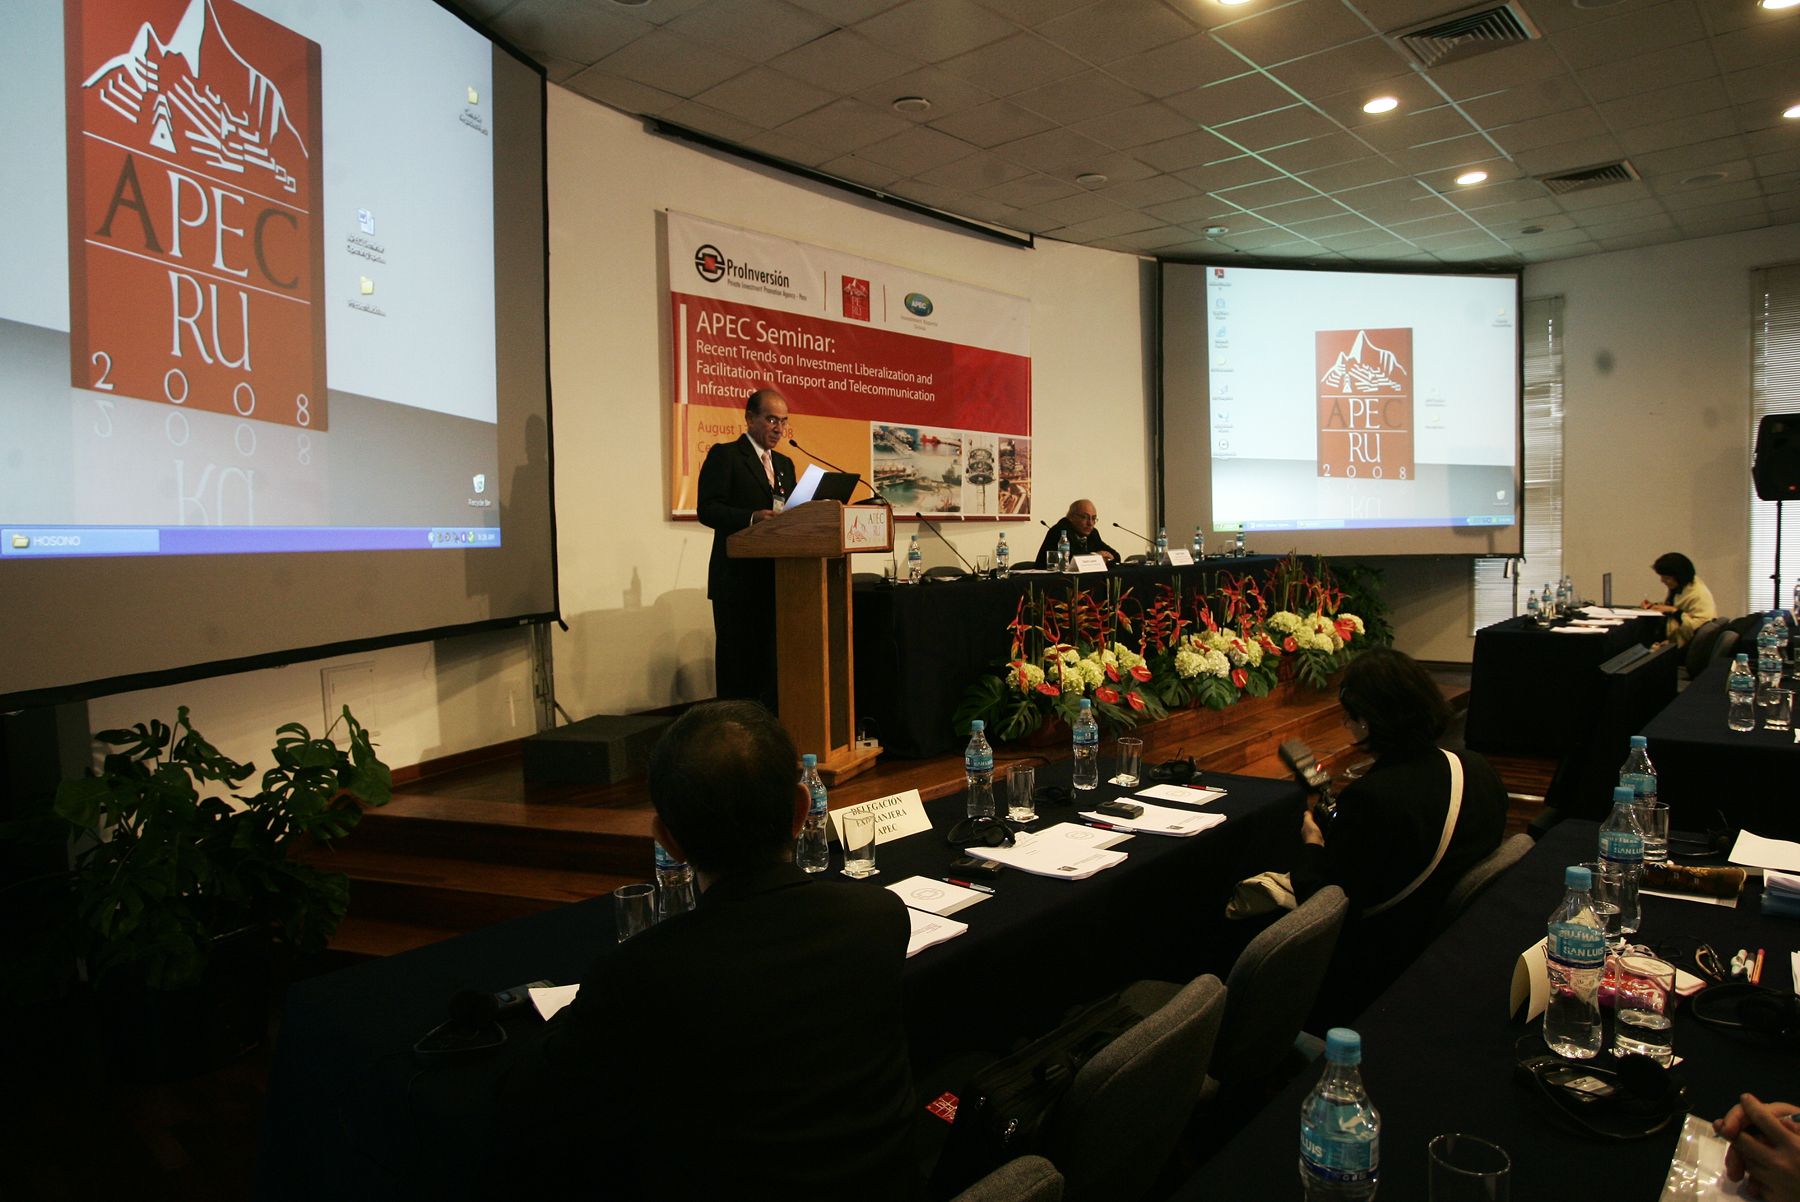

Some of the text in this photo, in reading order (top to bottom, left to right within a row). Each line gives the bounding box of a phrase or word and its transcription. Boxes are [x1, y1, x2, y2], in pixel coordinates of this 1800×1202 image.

[95, 154, 298, 289] APEC
[727, 258, 790, 288] ProInversión
[168, 270, 251, 371] RU
[696, 311, 836, 354] APEC Seminar:
[696, 339, 933, 385] Recent Trends on Investment Liberalization and
[696, 360, 935, 402] Facilitation in Transport and Telecommunication
[697, 380, 757, 398] Infrastruc
[1327, 398, 1404, 428] APEC
[697, 421, 734, 437] August
[1349, 432, 1381, 463] RU
[33, 535, 81, 547] HOSONO
[878, 824, 898, 836] APEC
